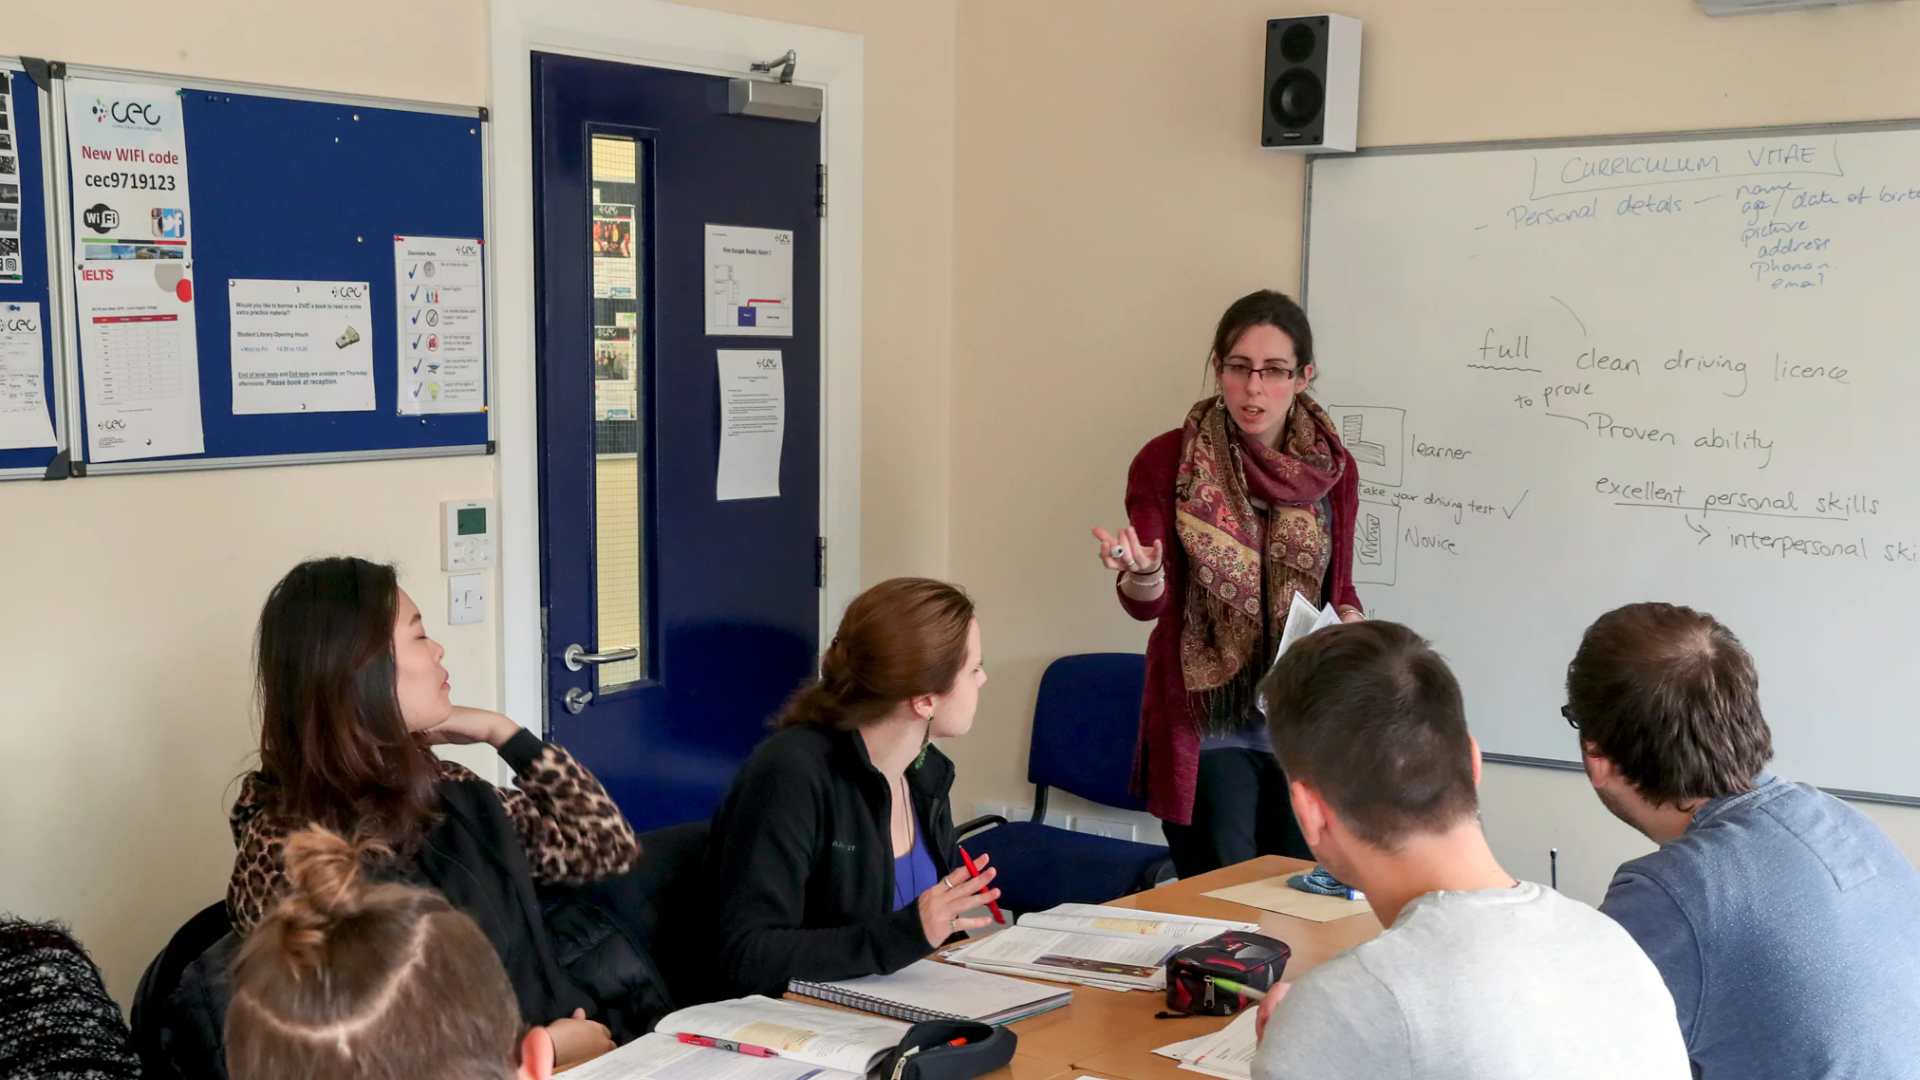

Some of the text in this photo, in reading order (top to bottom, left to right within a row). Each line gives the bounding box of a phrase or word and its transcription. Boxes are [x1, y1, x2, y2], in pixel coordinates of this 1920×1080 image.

[81, 145, 179, 165] New WIFI code
[1561, 144, 1817, 184] CURRICULUM VITAE
[85, 172, 176, 191] cec9719123
[1507, 198, 1598, 230] Personal
[1791, 191, 1839, 209] date
[1741, 220, 1808, 248] picture
[1758, 238, 1830, 258] address
[82, 269, 114, 281] IELTS
[1480, 327, 1851, 398] full clean driving licence
[266, 378, 285, 386] Please
[1514, 383, 1594, 408] to prove
[1411, 433, 1472, 460] learner
[1588, 412, 1774, 470] Proven ability
[1391, 489, 1418, 508] your
[1424, 492, 1463, 525] driving
[1468, 501, 1496, 515] test
[1595, 477, 1880, 518] excellent personal skills
[1405, 525, 1459, 555] Novice
[1727, 526, 1868, 559] interpersonal
